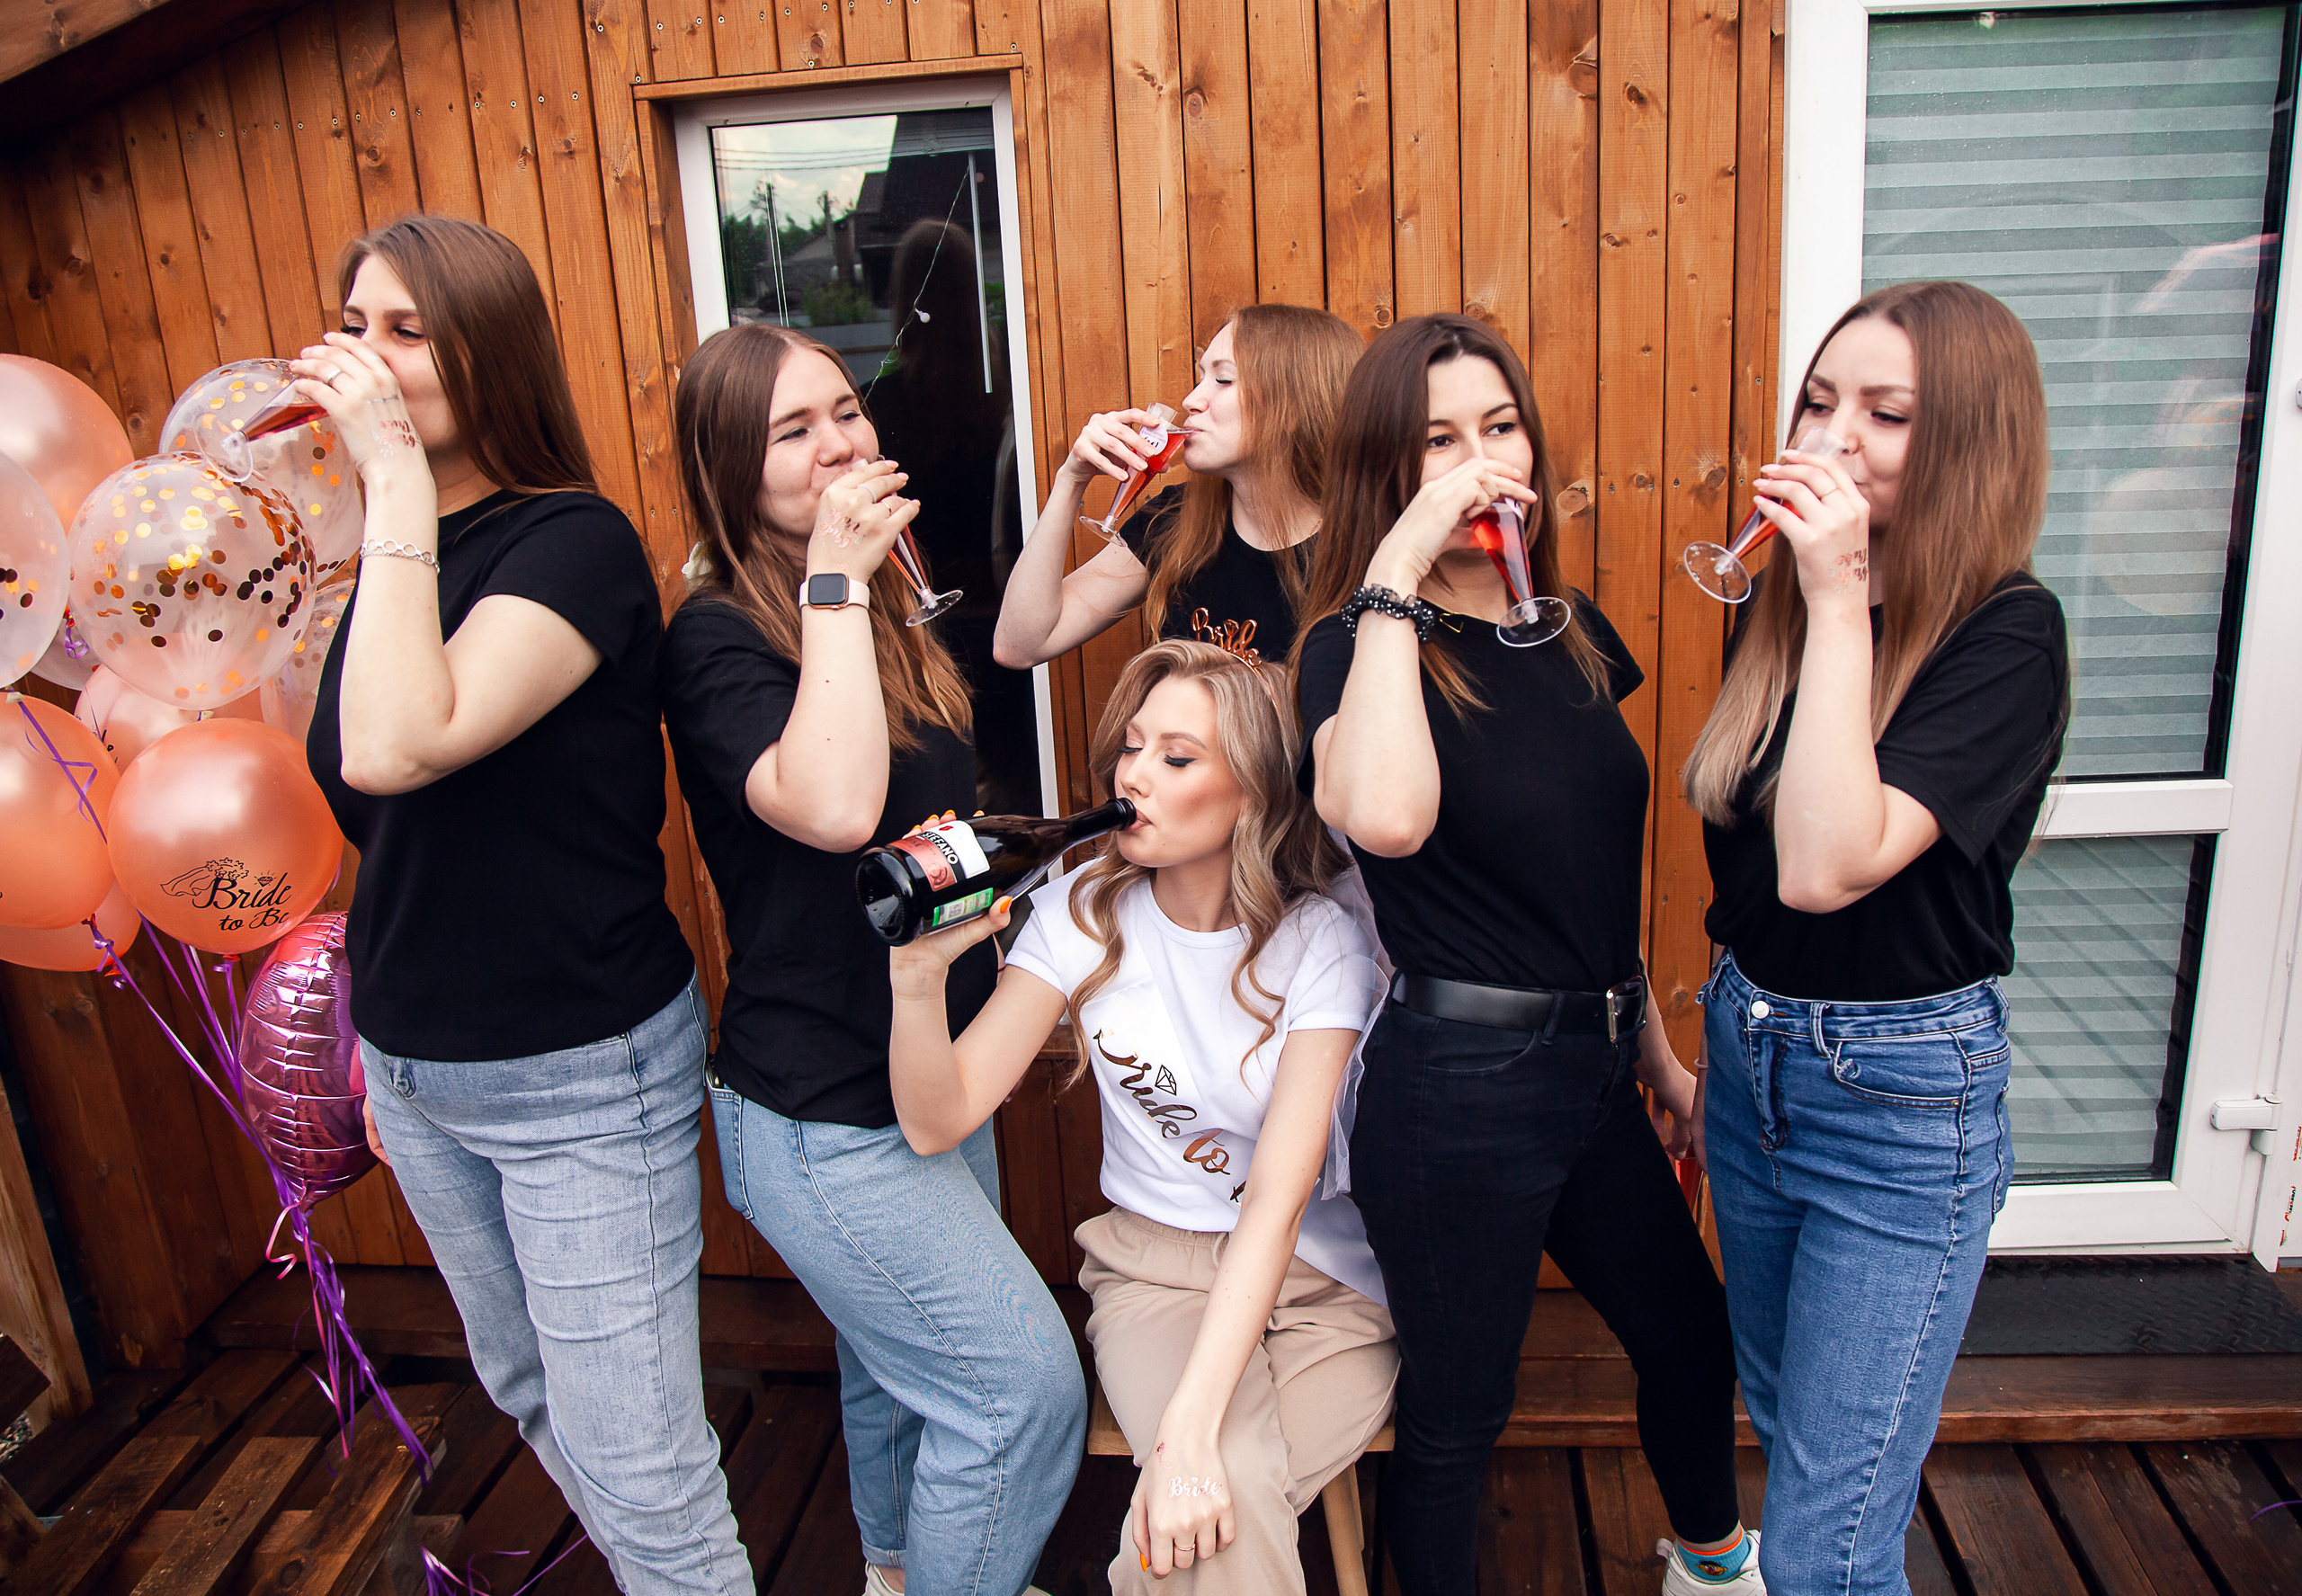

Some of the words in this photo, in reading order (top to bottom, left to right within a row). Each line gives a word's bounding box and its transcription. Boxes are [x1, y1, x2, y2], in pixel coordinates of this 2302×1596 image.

[192, 872, 292, 909] Bride
[219, 914, 245, 932] to
[1168, 1476, 1220, 1498] Bride
